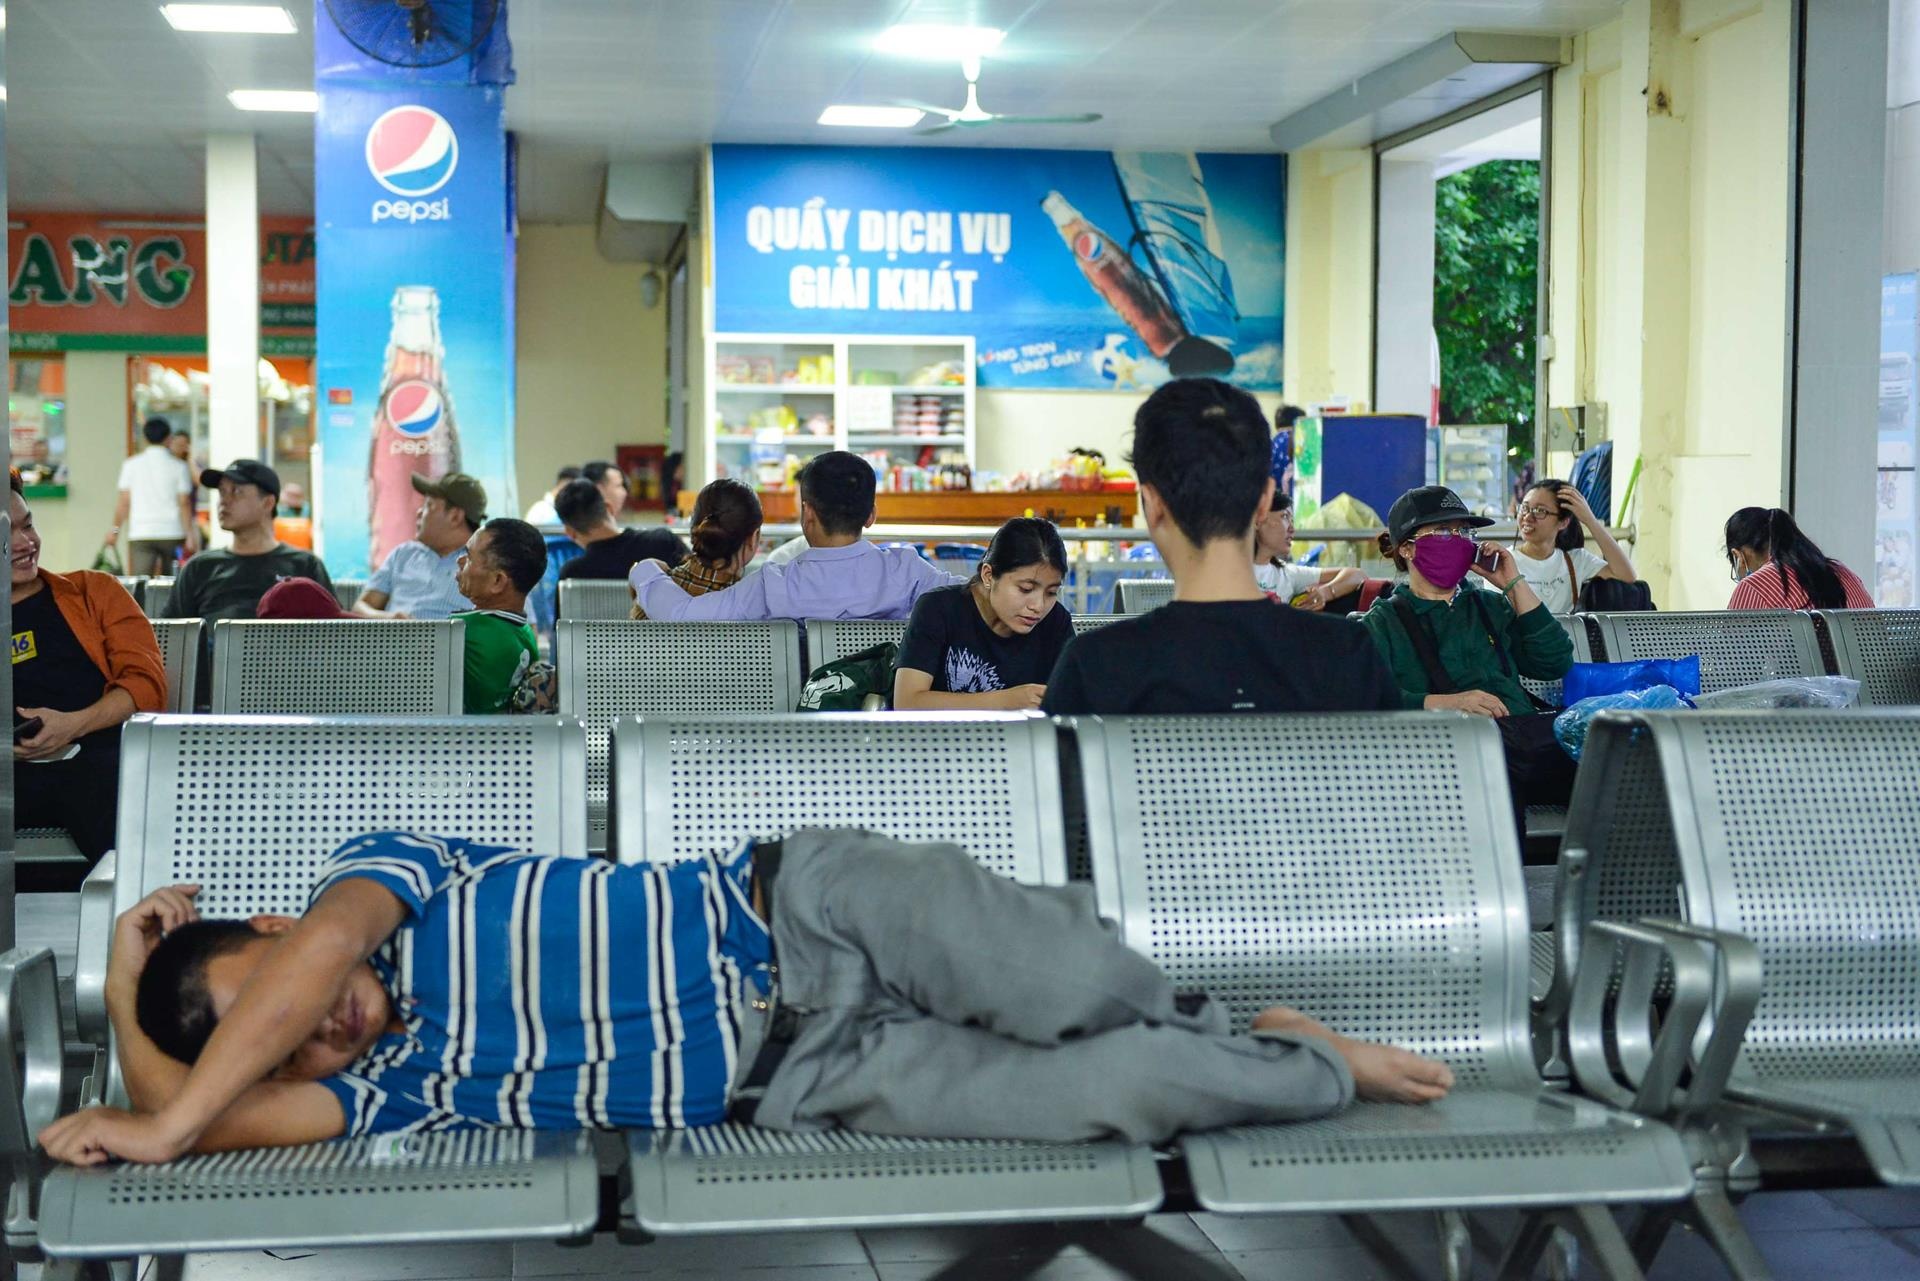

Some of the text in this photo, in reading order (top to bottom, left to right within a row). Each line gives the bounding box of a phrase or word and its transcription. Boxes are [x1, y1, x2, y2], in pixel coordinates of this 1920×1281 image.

[372, 197, 449, 223] pepsi
[858, 209, 952, 262] DỊCH
[958, 212, 1012, 263] VỤ
[789, 254, 978, 312] GIẢI KHÁT
